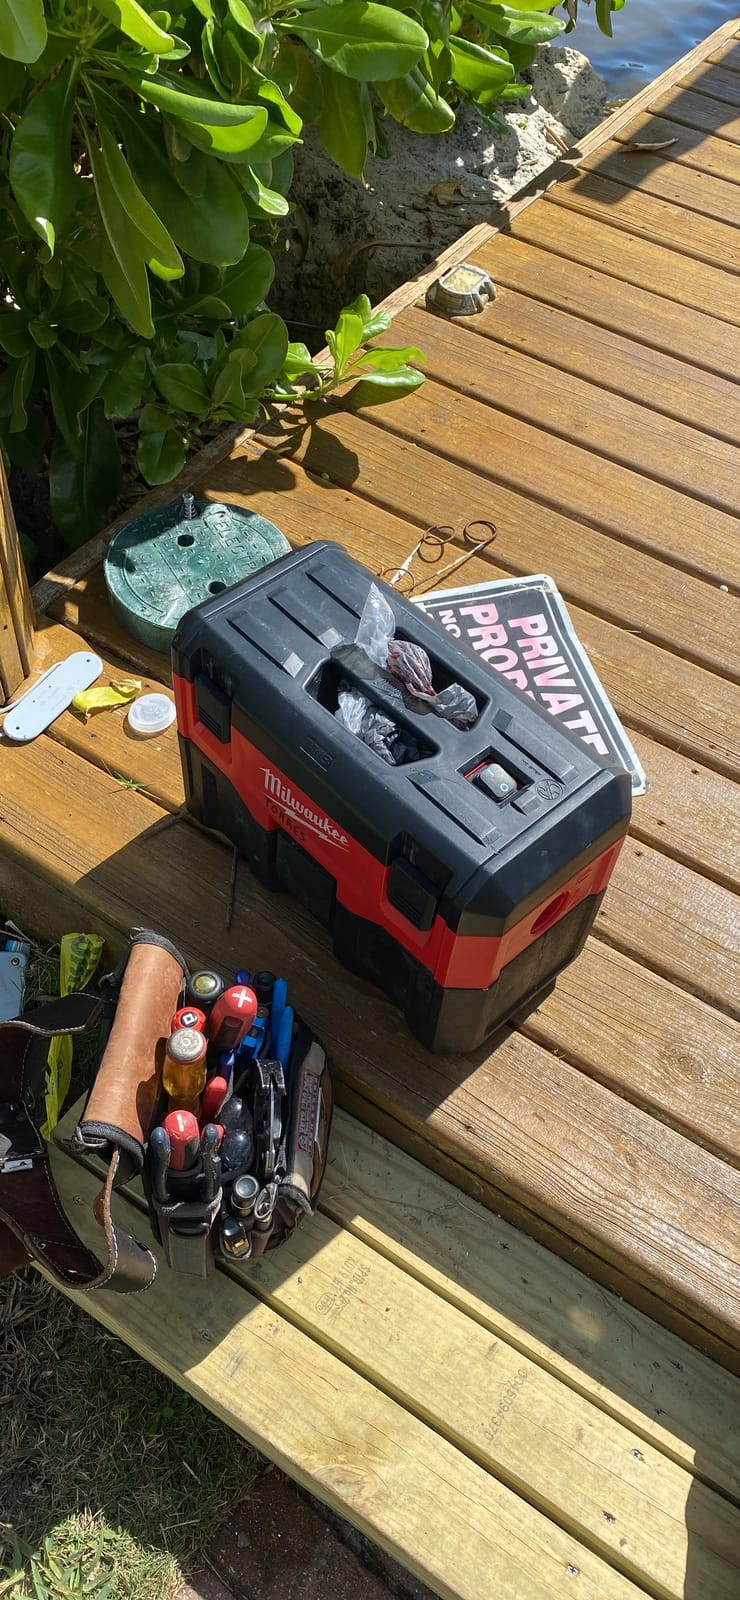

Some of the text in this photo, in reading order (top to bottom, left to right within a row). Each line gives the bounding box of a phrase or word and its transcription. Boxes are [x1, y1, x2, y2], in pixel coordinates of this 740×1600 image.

[213, 521, 257, 574] ELECTR
[459, 603, 535, 701] PROP
[508, 613, 610, 756] PRIVATE
[260, 767, 350, 847] Milwaukee
[264, 797, 305, 842] TORRES
